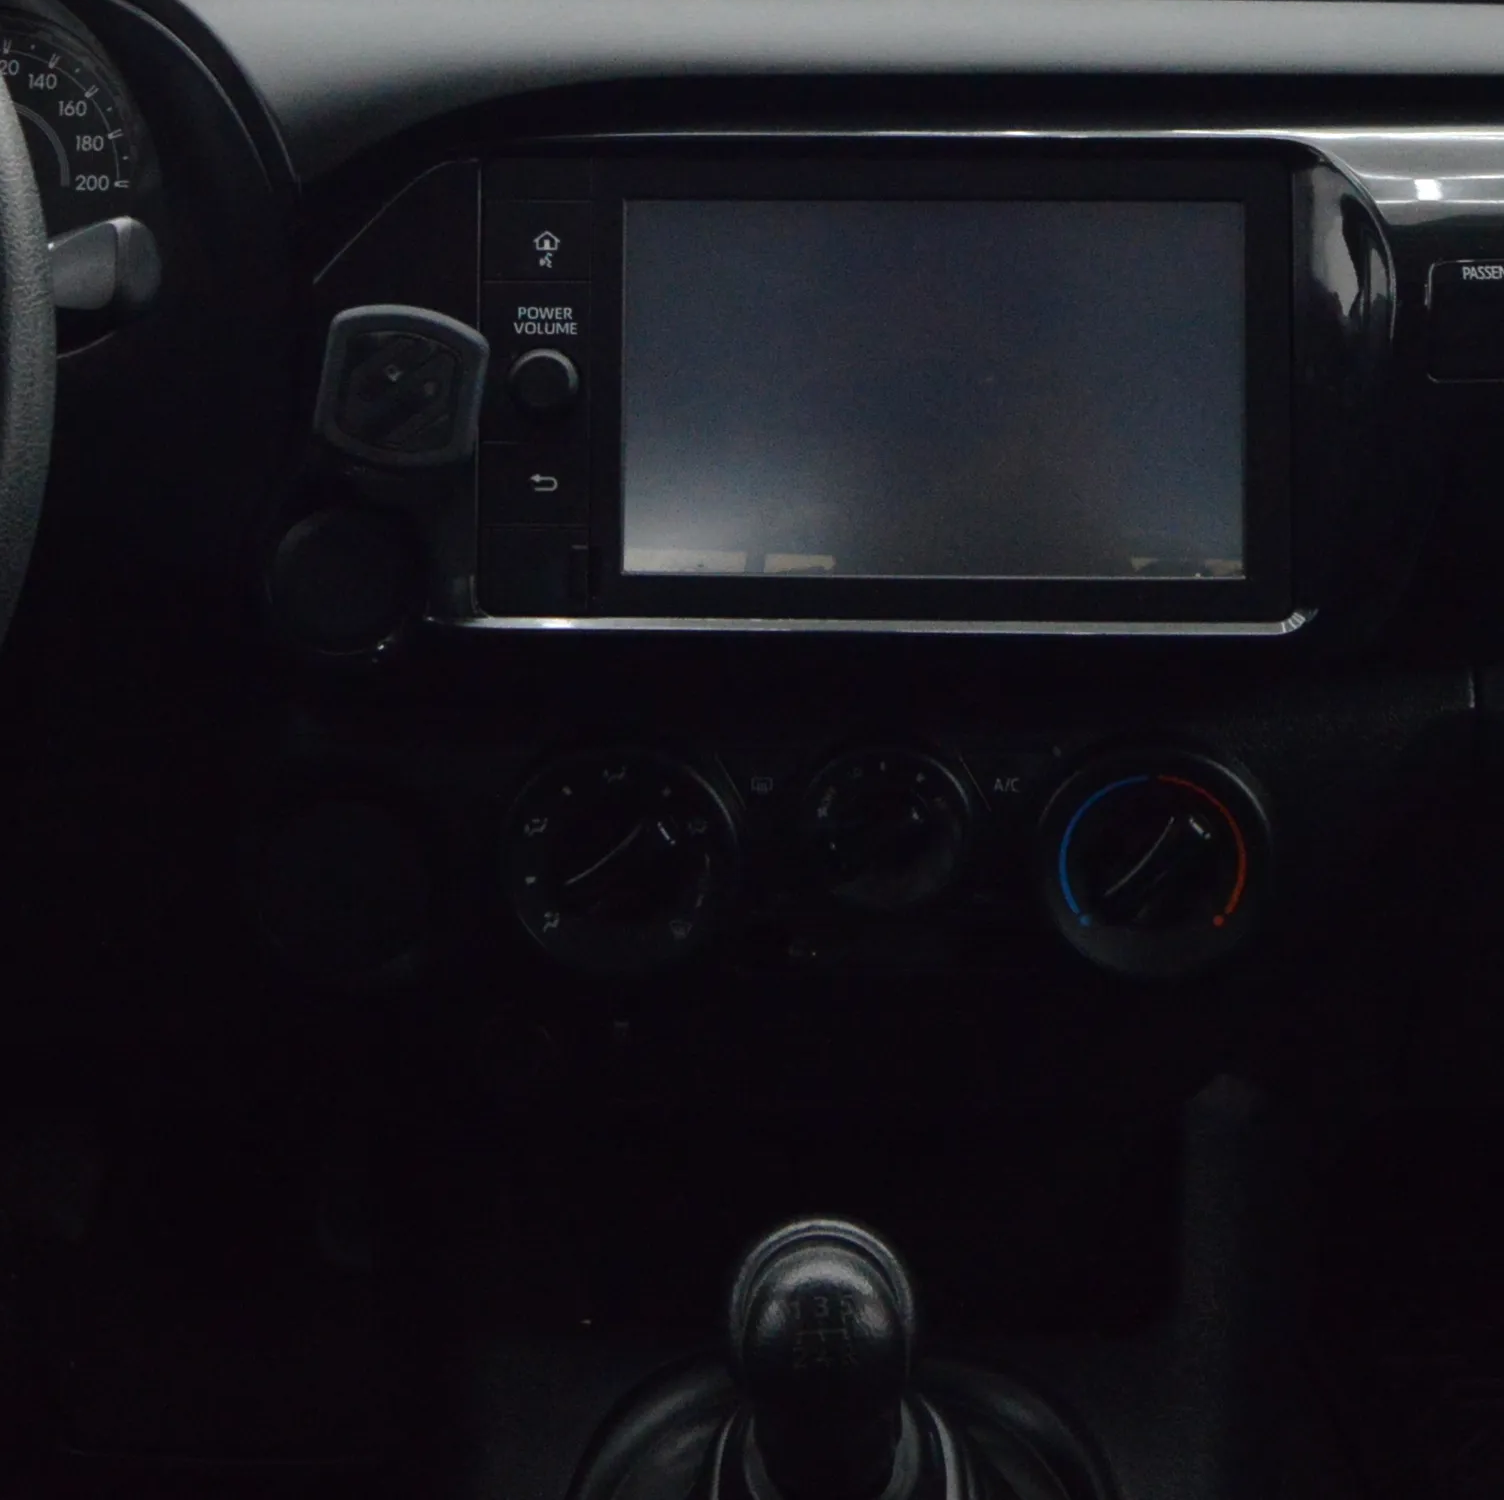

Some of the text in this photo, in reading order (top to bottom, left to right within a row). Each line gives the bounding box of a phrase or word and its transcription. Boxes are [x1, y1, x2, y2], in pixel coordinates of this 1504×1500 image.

[28, 73, 58, 90] 140
[58, 100, 87, 116] 160
[76, 135, 104, 151] 180
[75, 174, 109, 191] 200
[517, 306, 573, 320] POWER
[513, 321, 578, 336] VOLUME
[992, 776, 1021, 794] A/C
[813, 1296, 830, 1318] 3
